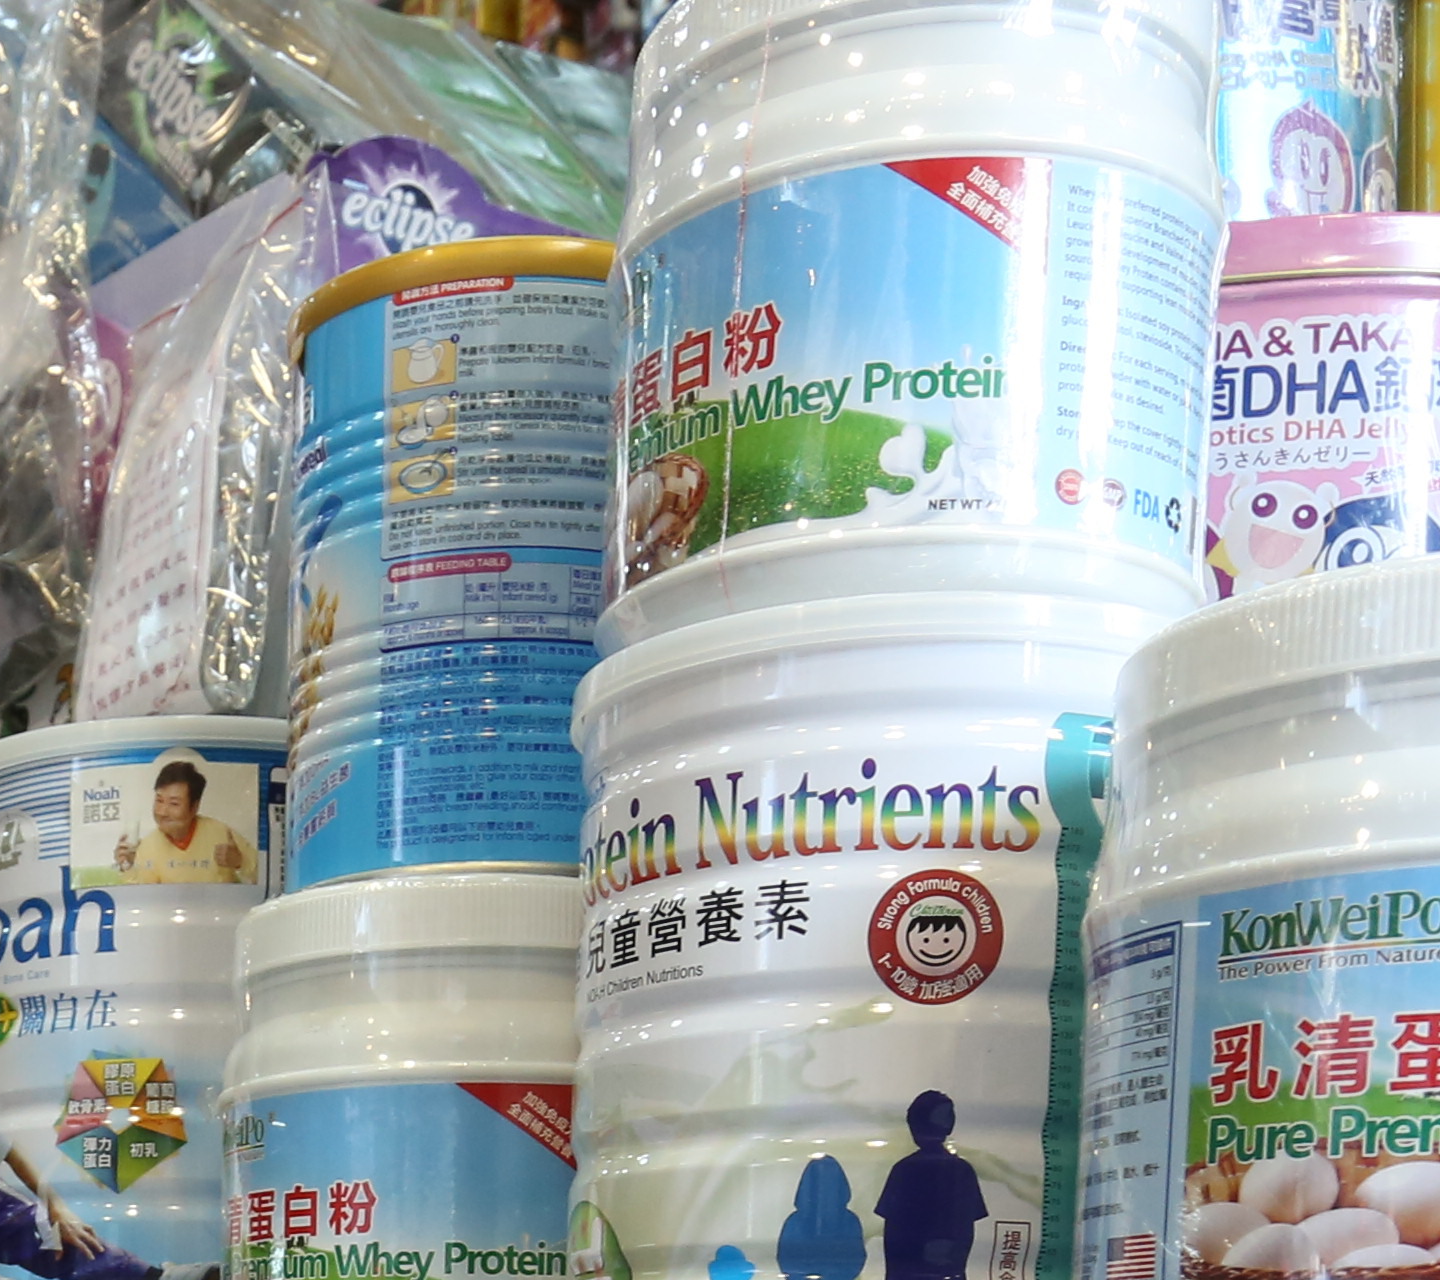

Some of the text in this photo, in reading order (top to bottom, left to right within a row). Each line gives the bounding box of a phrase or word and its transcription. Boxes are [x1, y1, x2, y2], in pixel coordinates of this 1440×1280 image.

[124, 40, 216, 143] eclipse
[342, 183, 475, 244] eclipse
[1268, 326, 1294, 356] &
[731, 372, 853, 429] Whey
[1133, 489, 1160, 524] FDA
[82, 786, 120, 802] Noah
[694, 758, 1040, 873] Nutrients
[1218, 964, 1248, 980] The
[1252, 958, 1313, 980] Power
[1318, 952, 1371, 972] From
[19, 988, 118, 1037] 關自在
[1206, 1111, 1315, 1165] Pure
[444, 1241, 567, 1276] Protein
